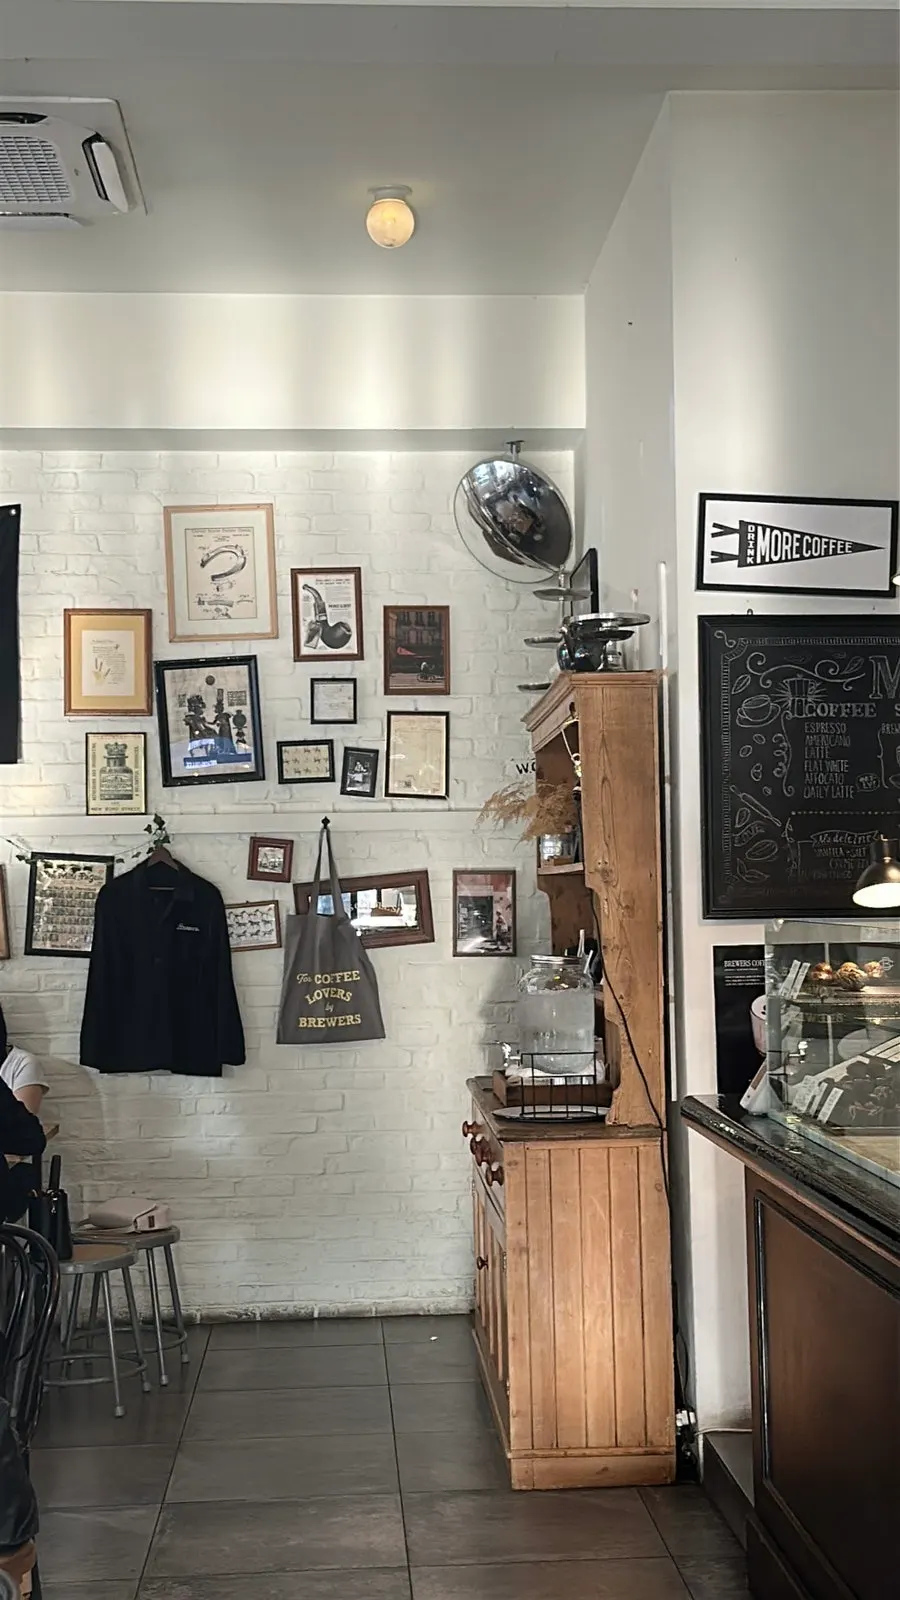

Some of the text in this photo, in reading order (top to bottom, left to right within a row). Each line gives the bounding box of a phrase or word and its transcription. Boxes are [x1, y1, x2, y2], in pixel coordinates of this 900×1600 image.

[746, 525, 755, 564] DRINK
[756, 525, 853, 564] MORE COFFEE
[805, 702, 877, 718] COFFEE
[804, 722, 847, 734] ESPRESSO
[804, 735, 851, 747] AMERICANO
[804, 746, 831, 759] LATTE
[804, 760, 849, 772] FLAT WHITE
[831, 785, 854, 799] LATTE
[296, 970, 361, 985] For COFFEE
[304, 987, 353, 1005] LOVERS
[325, 1002, 334, 1012] by
[298, 1014, 361, 1028] BREWERS
